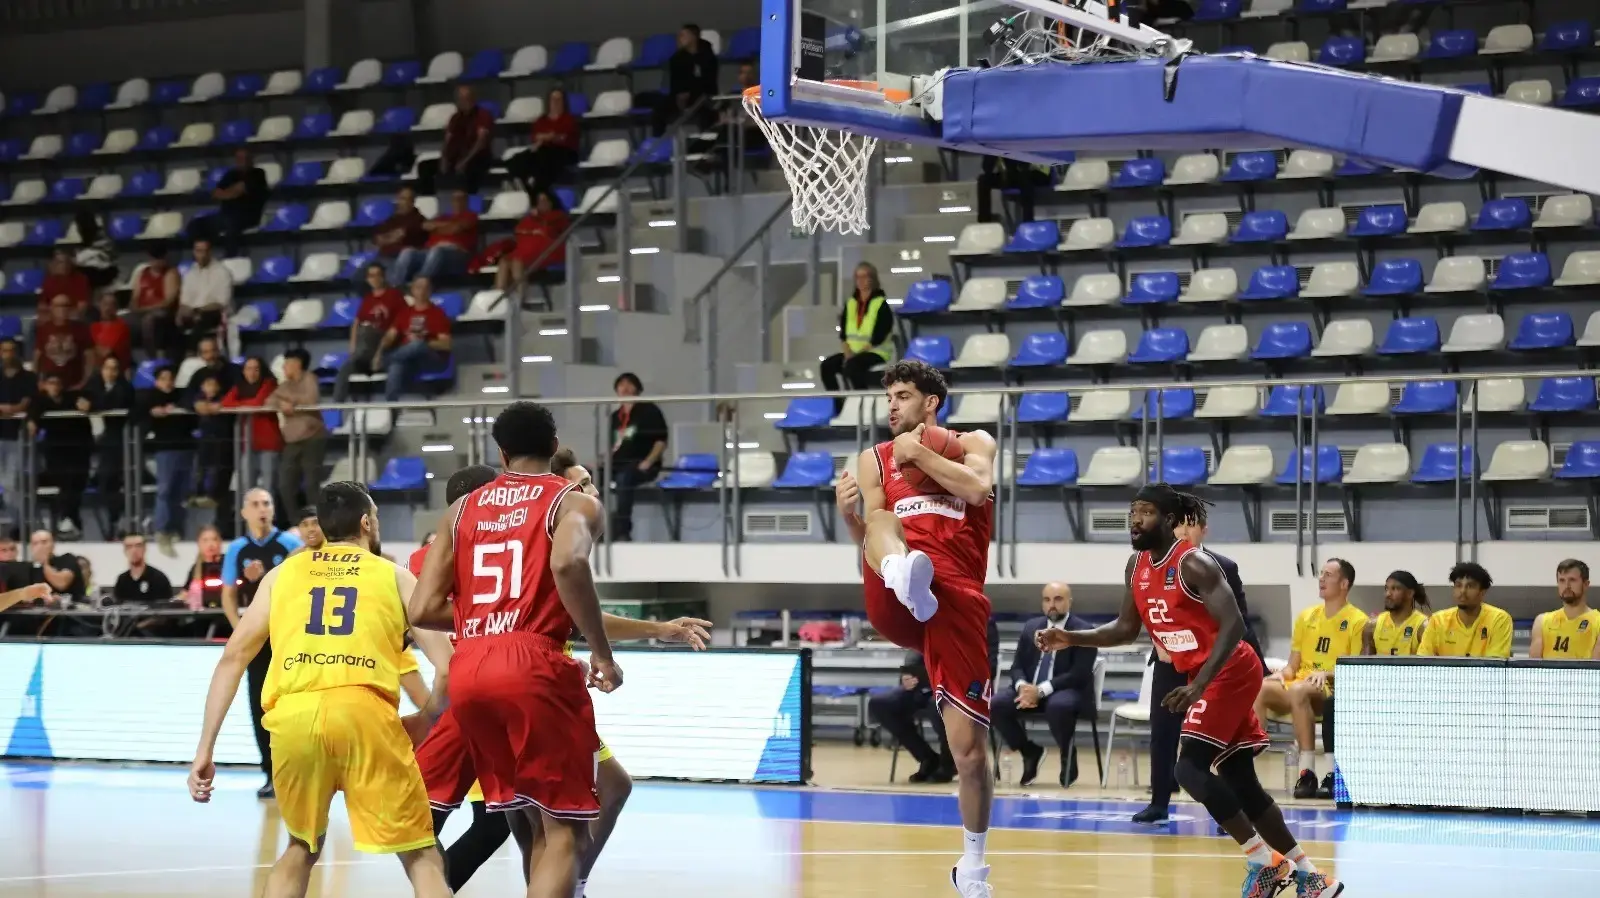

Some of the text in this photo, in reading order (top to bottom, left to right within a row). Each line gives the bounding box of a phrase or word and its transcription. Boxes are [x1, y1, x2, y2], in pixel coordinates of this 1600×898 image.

[477, 485, 544, 507] CABOCLO
[312, 551, 363, 562] PELOS
[472, 539, 523, 605] 51
[305, 586, 358, 635] 13
[1147, 598, 1174, 624] 22
[1315, 636, 1331, 653] 10
[1553, 636, 1570, 652] 14
[284, 653, 376, 670] Gan Canaria
